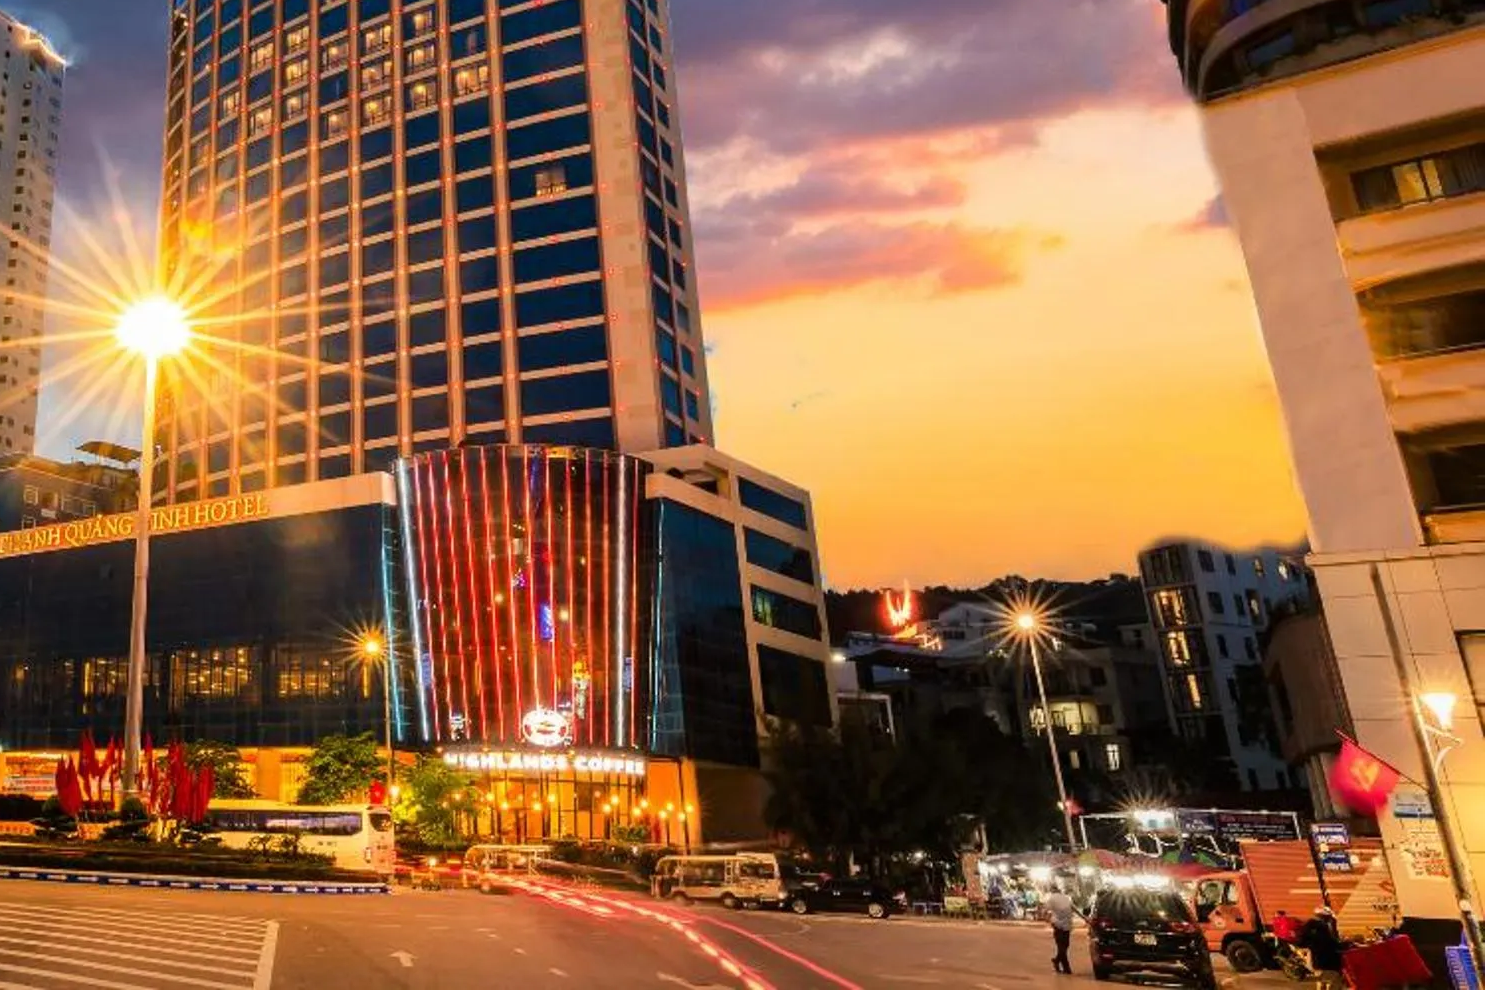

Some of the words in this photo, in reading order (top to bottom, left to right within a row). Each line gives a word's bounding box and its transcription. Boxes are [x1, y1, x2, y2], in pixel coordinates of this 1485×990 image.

[150, 505, 190, 530] INH
[194, 494, 268, 525] HOTEL
[443, 751, 568, 772] HIGHLANDS
[573, 755, 646, 776] COFFEE
